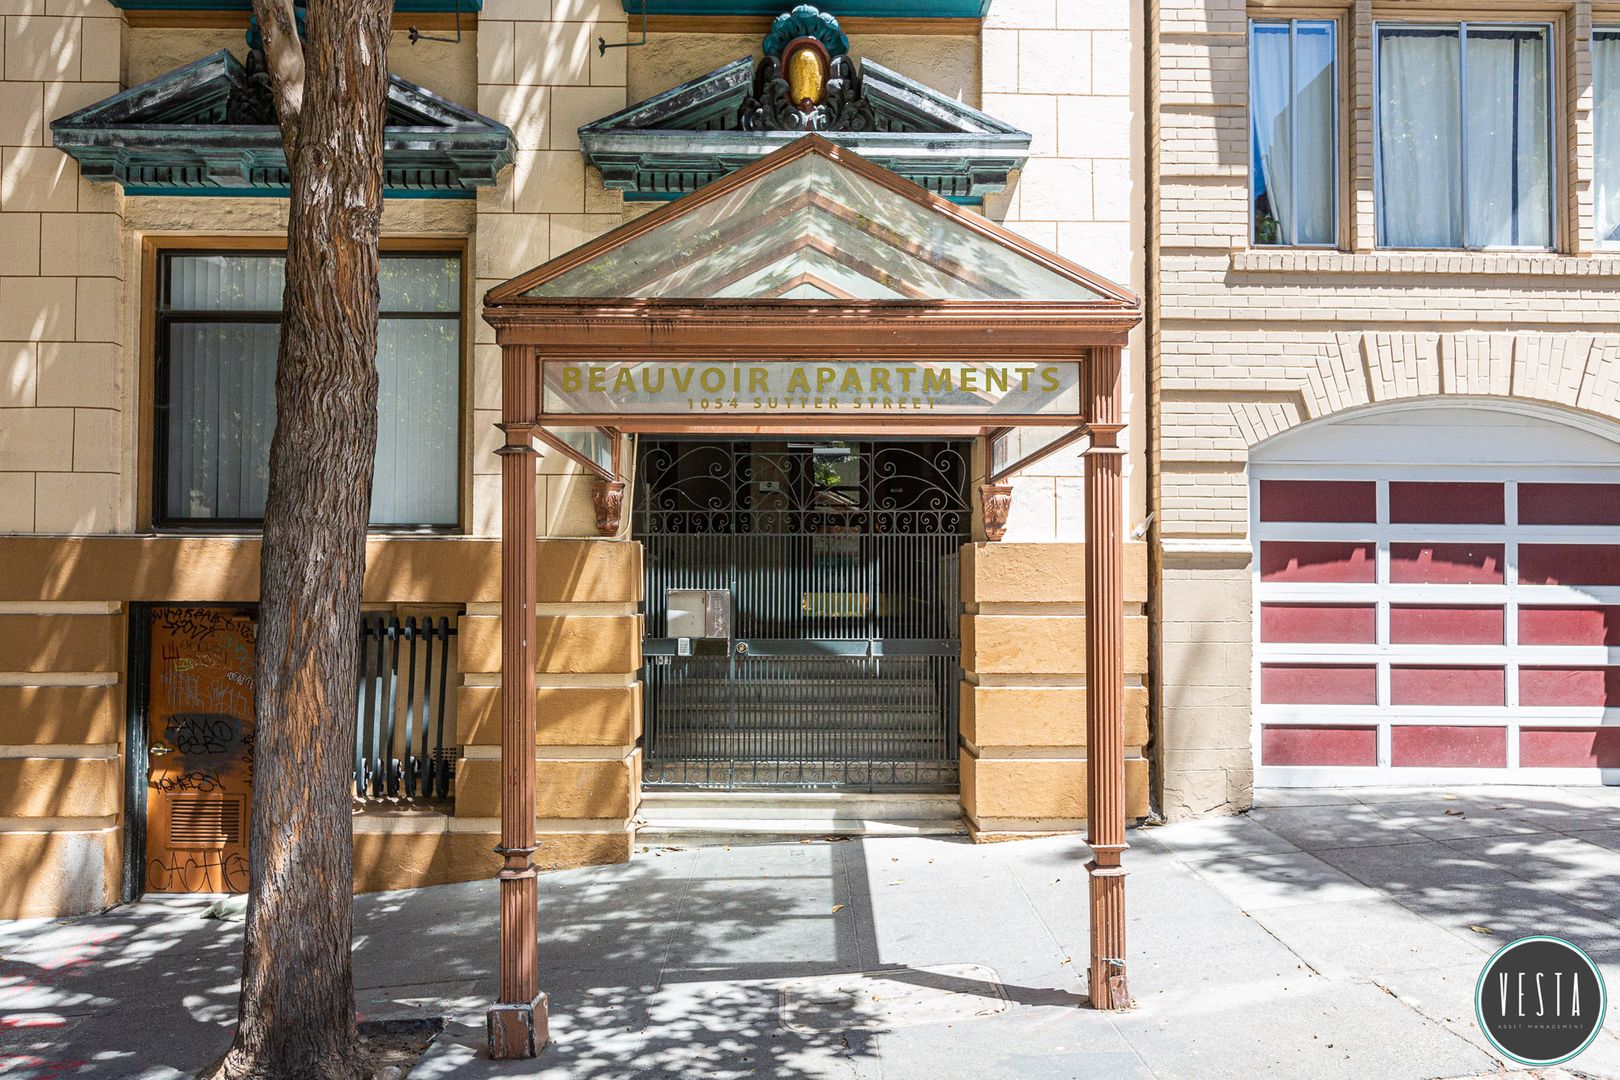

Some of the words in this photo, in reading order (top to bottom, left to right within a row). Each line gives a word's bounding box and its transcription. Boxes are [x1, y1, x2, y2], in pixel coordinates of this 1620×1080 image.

[562, 367, 769, 394] BEAUVOIR
[786, 367, 1060, 393] APARTMENTS
[688, 397, 738, 410] 1054
[753, 397, 838, 409] SUTTER
[853, 397, 938, 409] STREET
